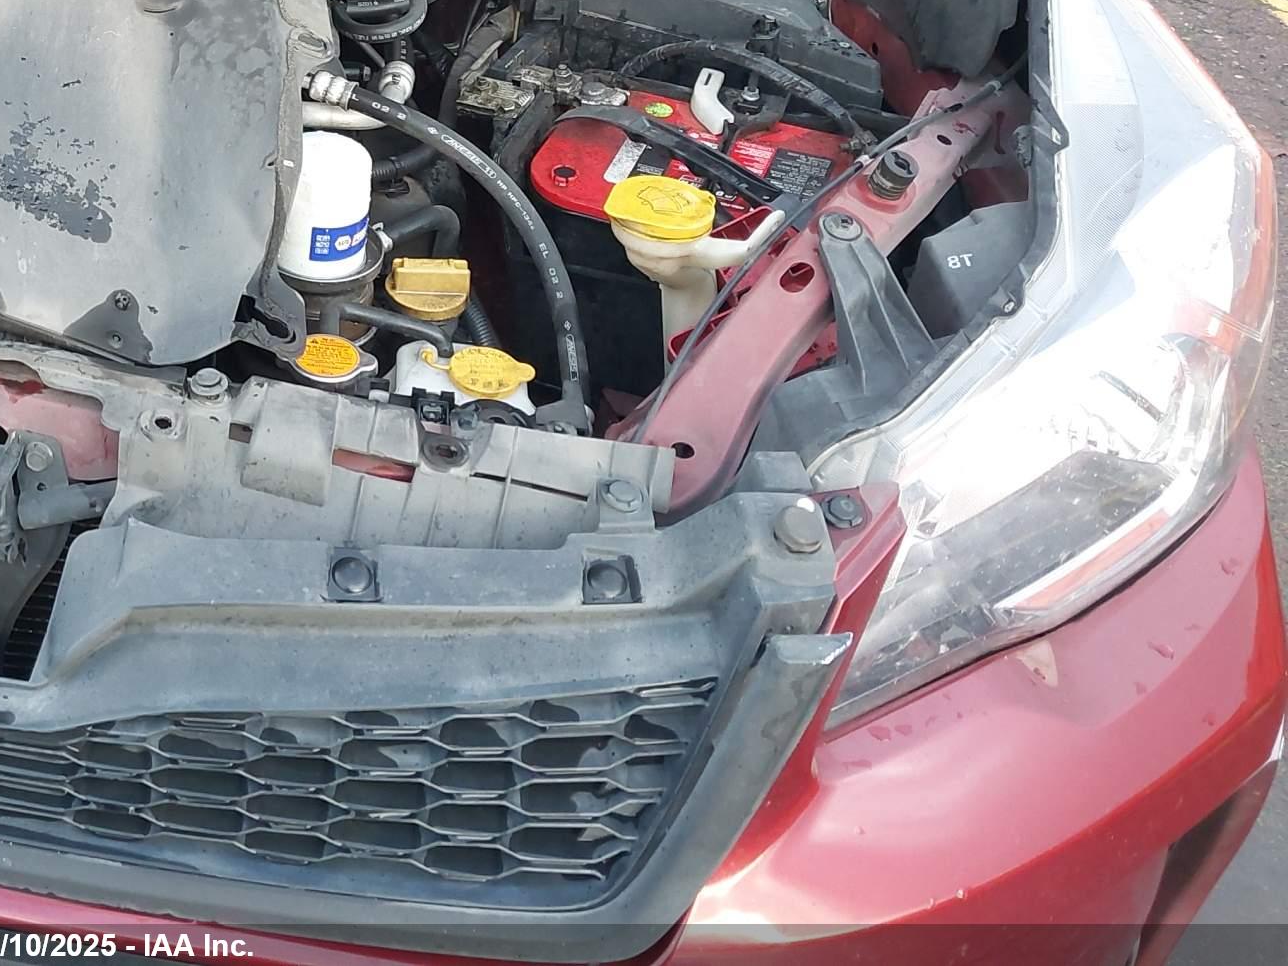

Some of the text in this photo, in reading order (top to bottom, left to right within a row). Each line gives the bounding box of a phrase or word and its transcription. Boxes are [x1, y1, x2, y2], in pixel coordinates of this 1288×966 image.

[372, 101, 391, 113] 02
[539, 242, 550, 259] EL
[548, 267, 560, 285] 02
